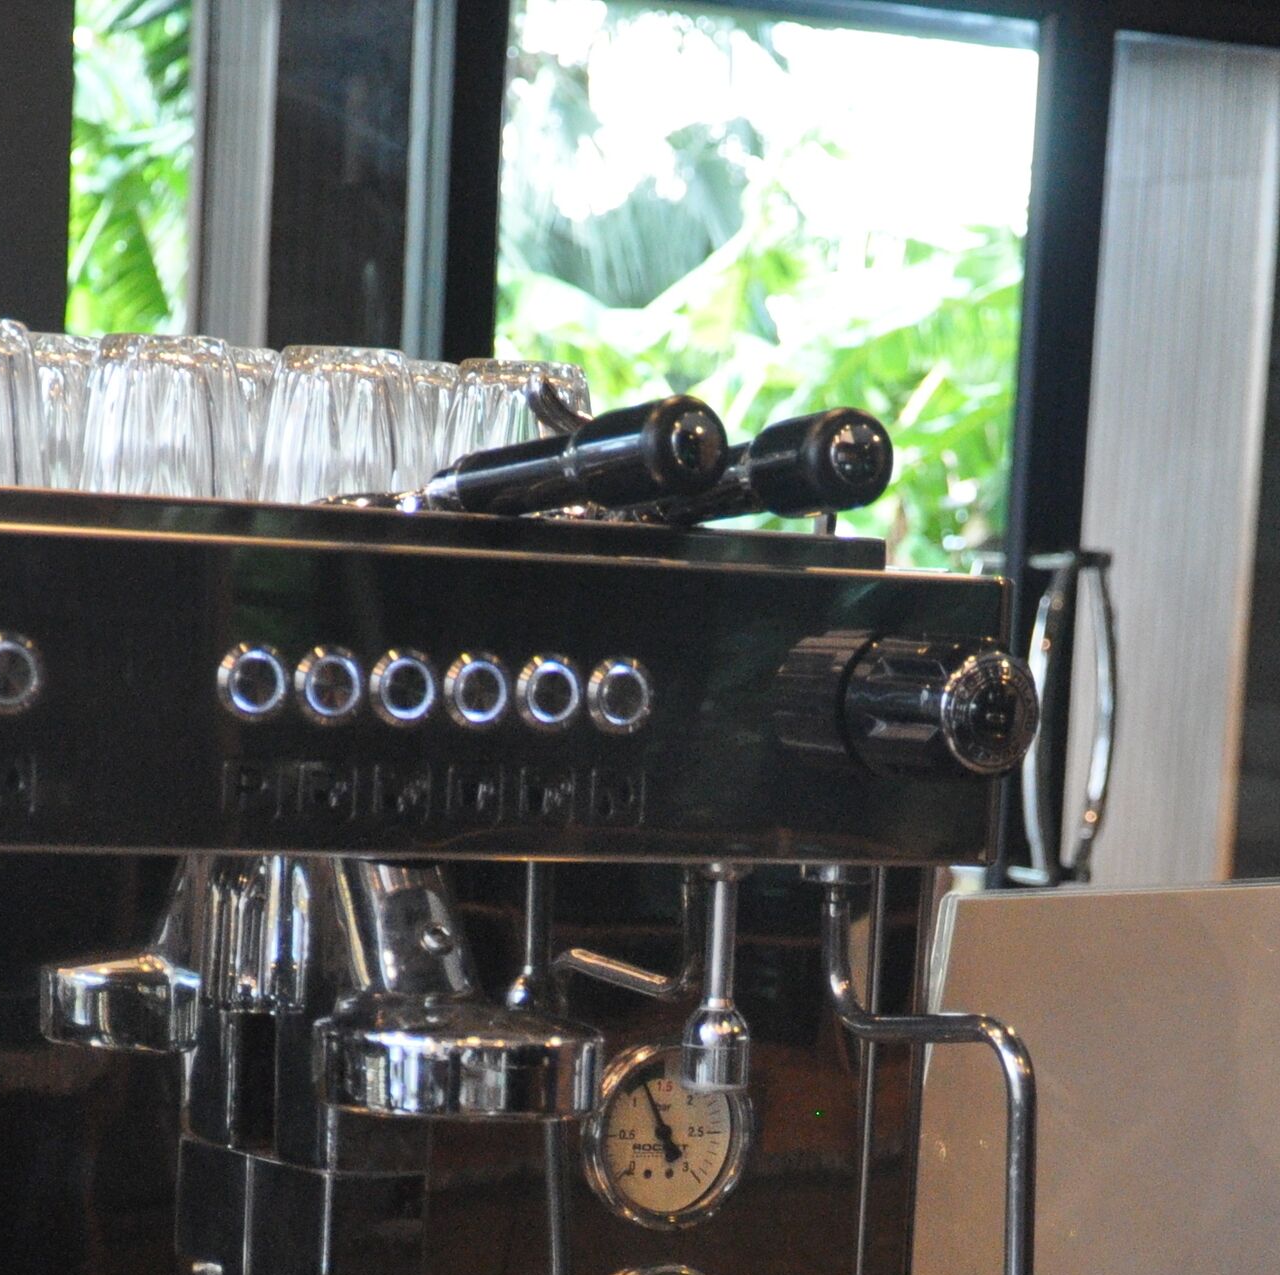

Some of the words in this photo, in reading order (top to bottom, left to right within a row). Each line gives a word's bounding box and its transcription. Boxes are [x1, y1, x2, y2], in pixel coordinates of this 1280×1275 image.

[657, 1081, 673, 1093] 1.5
[619, 1129, 636, 1140] 0.5
[688, 1126, 704, 1138] 2.5
[631, 1144, 689, 1152] ROCT
[682, 1161, 690, 1173] 3
